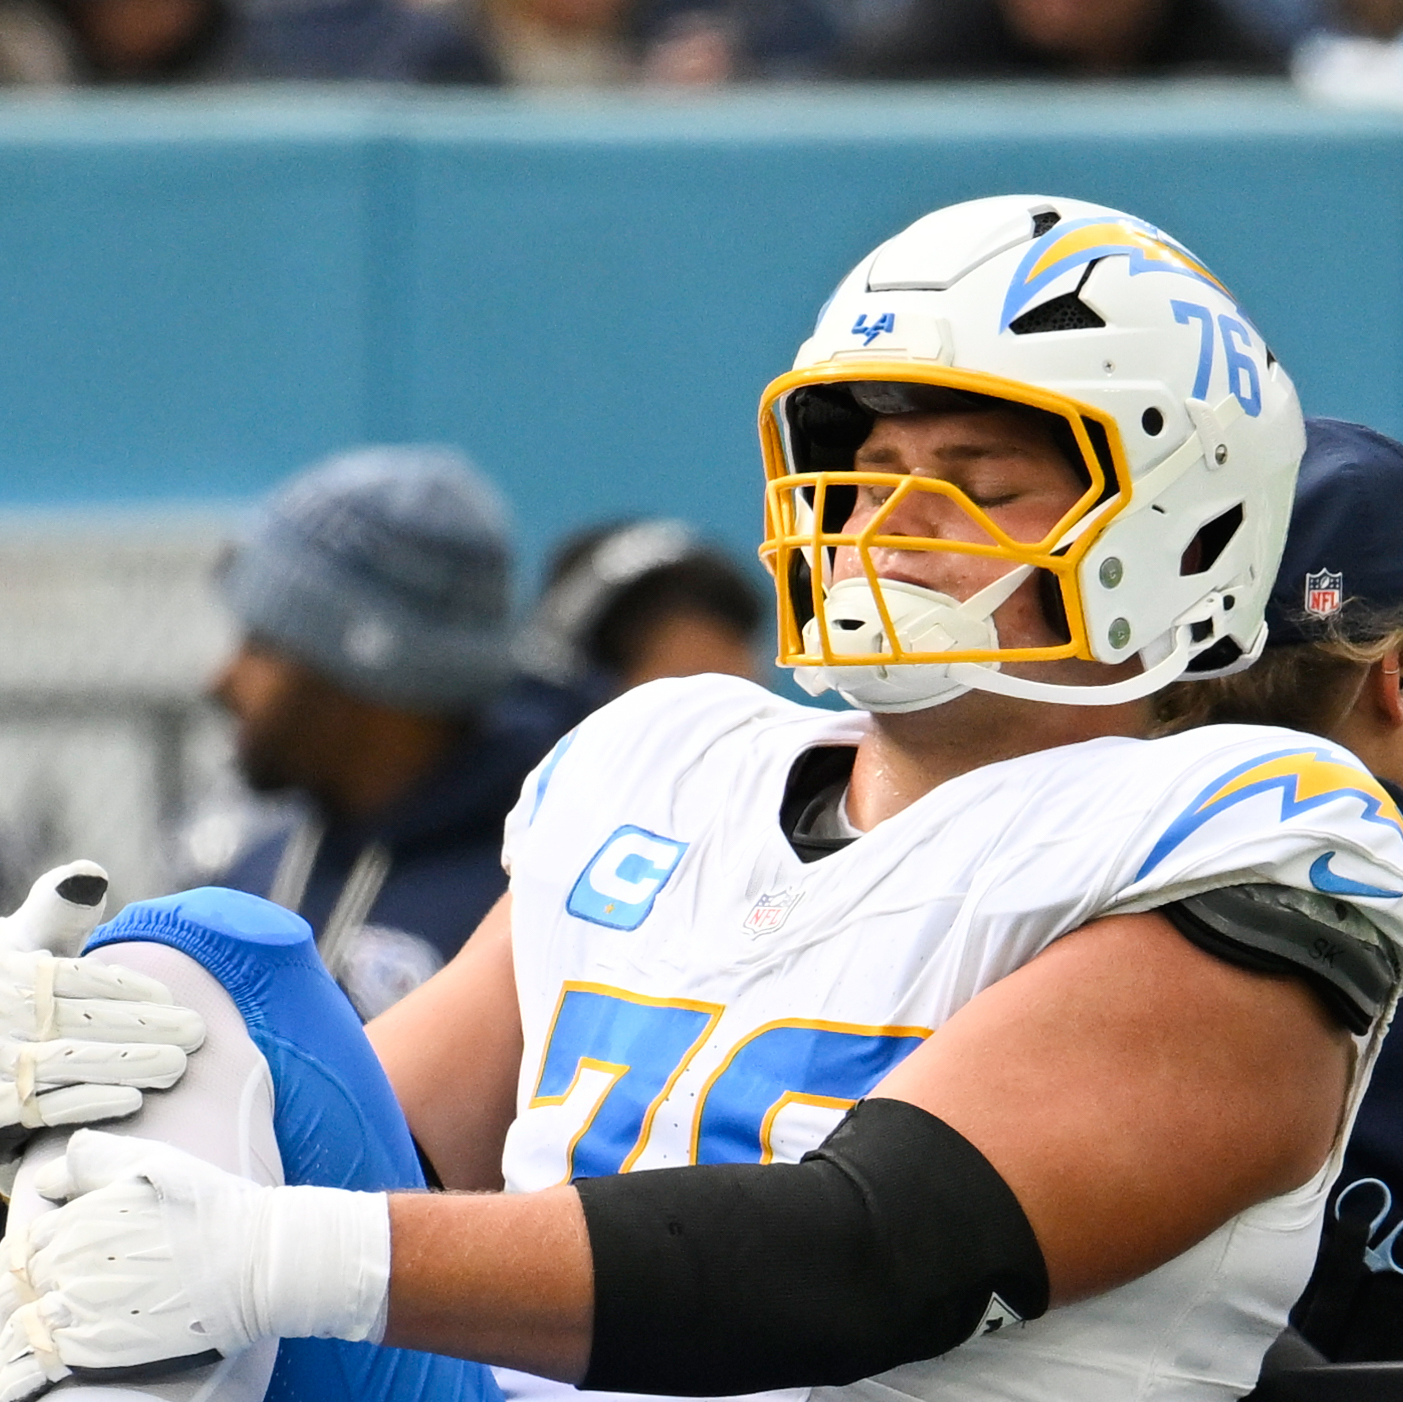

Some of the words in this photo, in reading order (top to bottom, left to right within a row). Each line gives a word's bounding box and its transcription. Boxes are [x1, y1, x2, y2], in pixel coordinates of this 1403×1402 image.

[1170, 299, 1262, 418] 76
[1311, 591, 1341, 613] NFL
[589, 833, 679, 905] C
[748, 908, 783, 928] NFL
